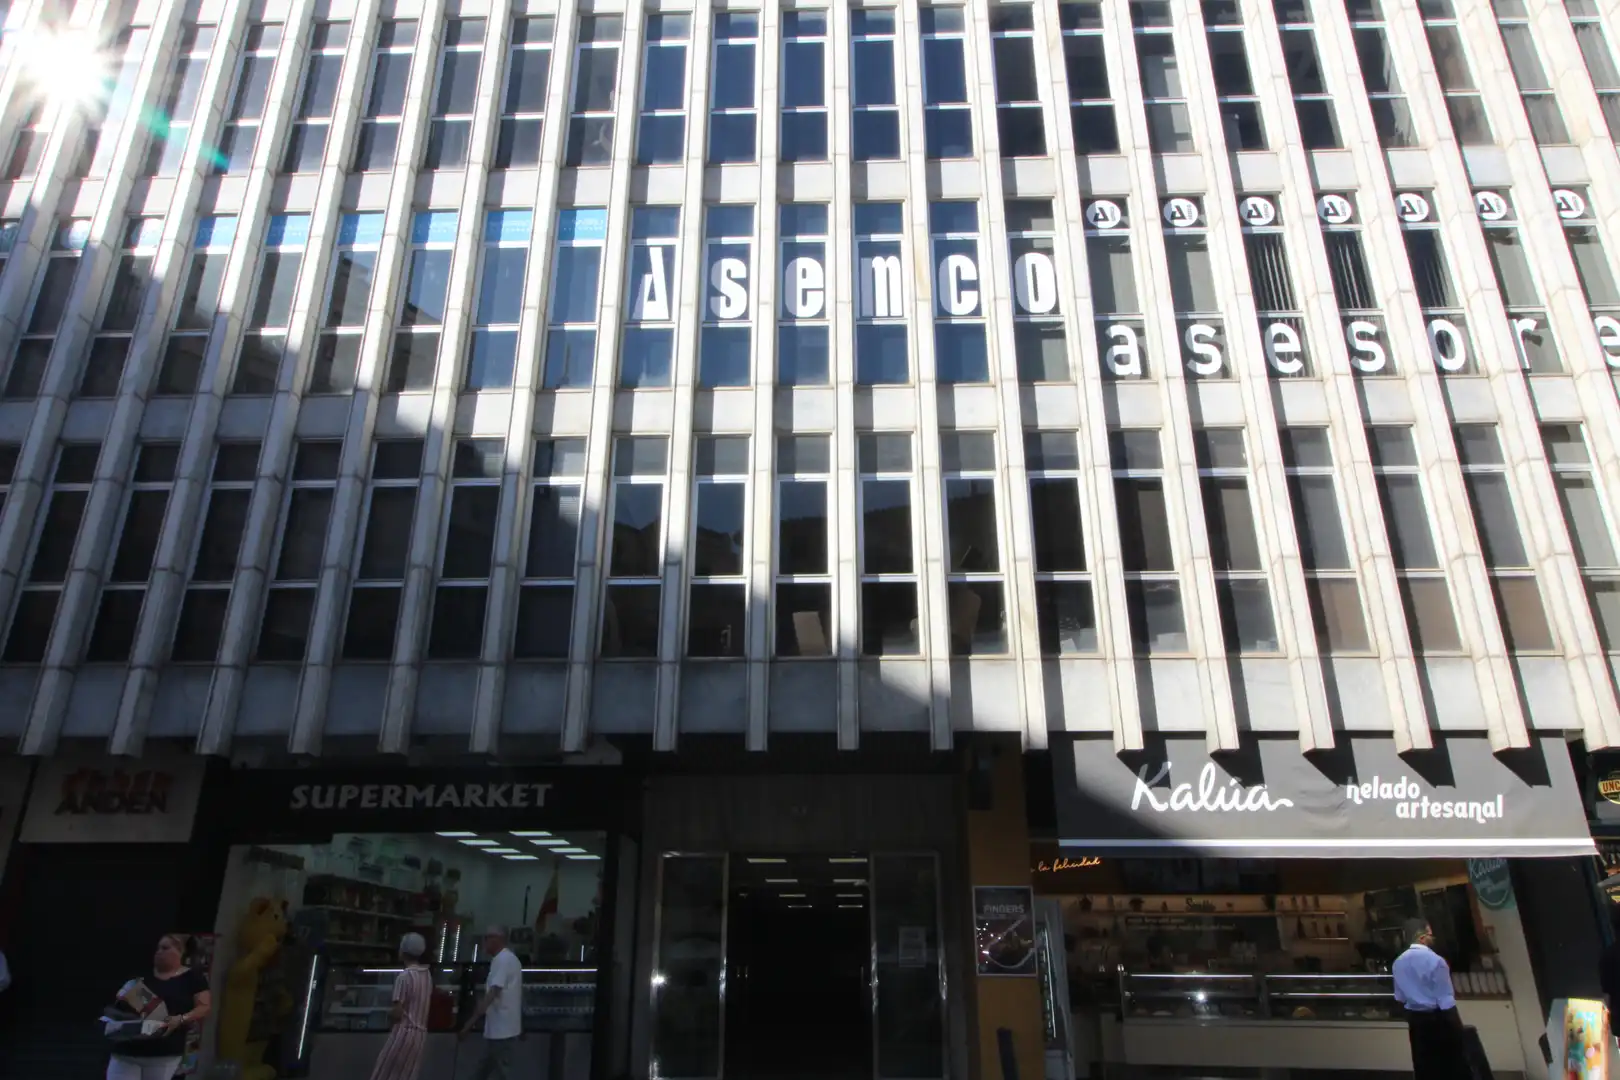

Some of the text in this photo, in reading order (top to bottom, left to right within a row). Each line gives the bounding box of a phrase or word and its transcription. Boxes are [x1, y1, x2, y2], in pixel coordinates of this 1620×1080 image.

[631, 246, 1058, 321] Asemco
[290, 783, 553, 809] SUPERMARKET
[1131, 762, 1293, 812] Kalúa
[1345, 776, 1420, 806] helado
[1395, 794, 1503, 824] artesanal
